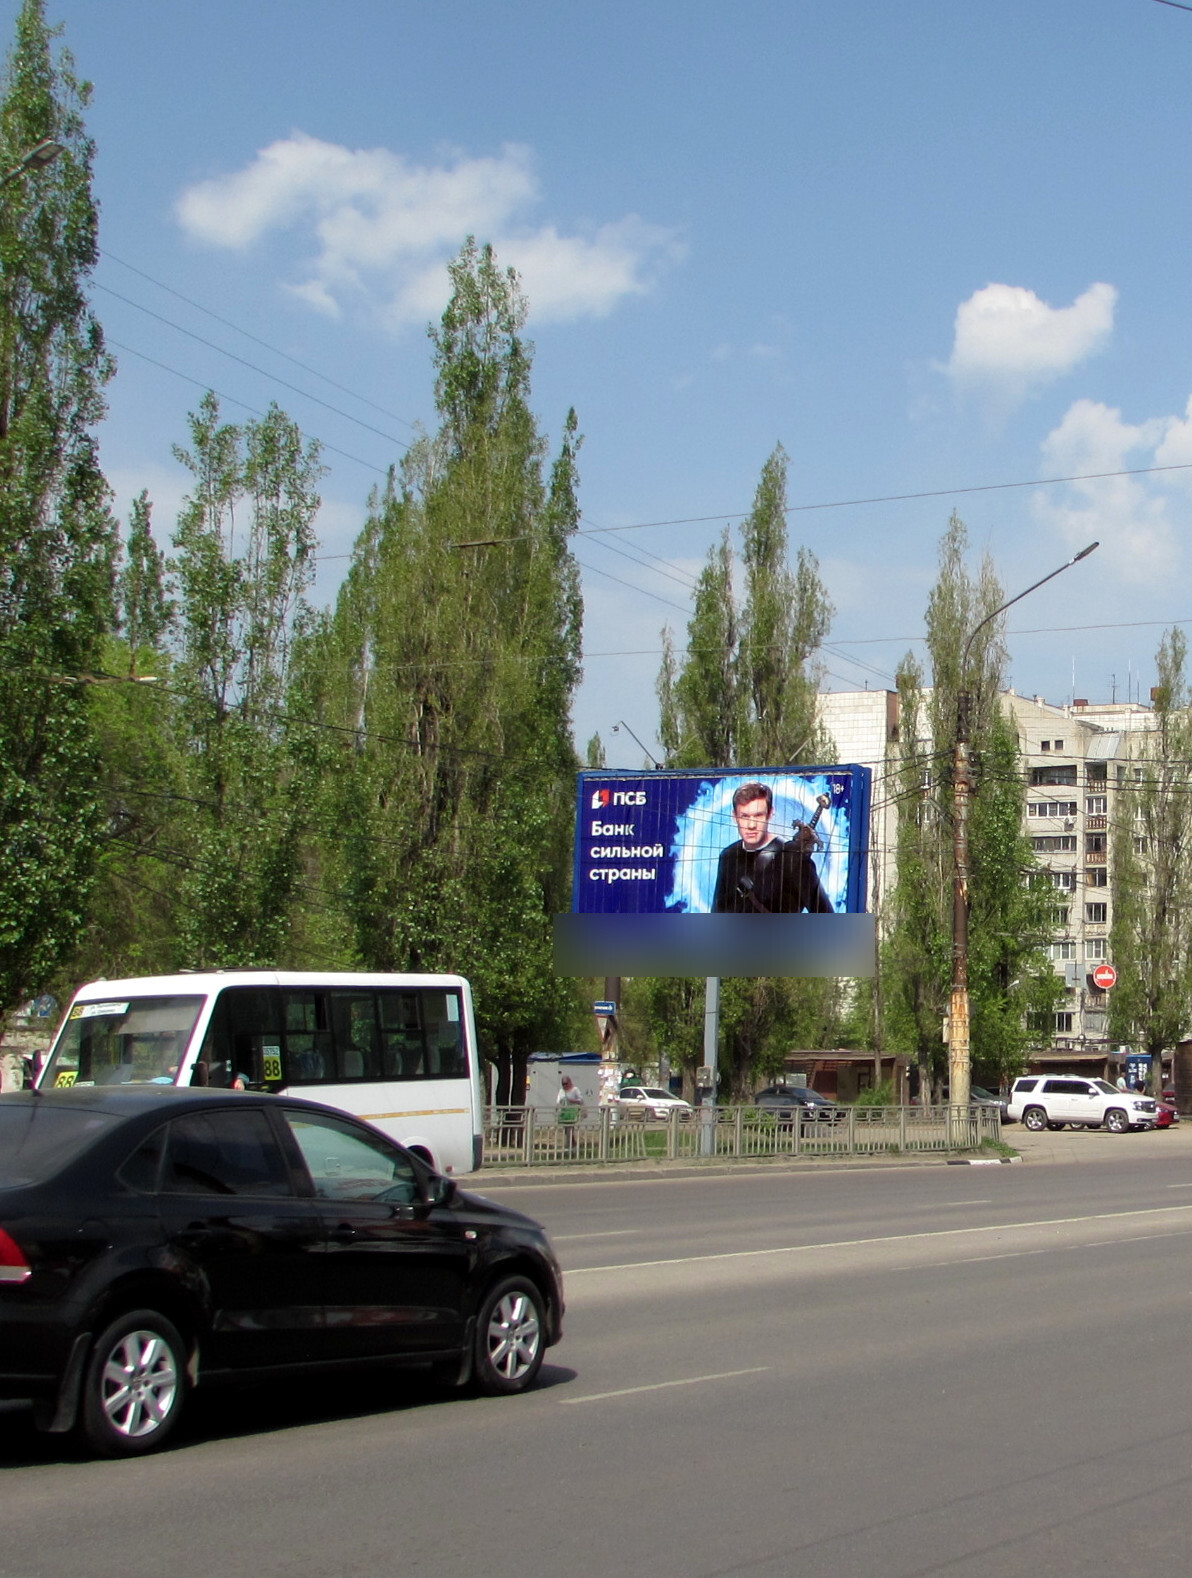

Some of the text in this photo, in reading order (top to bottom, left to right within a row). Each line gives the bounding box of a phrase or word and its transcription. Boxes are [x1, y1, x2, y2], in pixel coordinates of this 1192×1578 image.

[832, 783, 844, 795] 18+
[613, 791, 647, 806] ПСБ
[591, 820, 635, 836] Банк
[590, 843, 664, 858] сильной
[589, 867, 656, 884] страны
[264, 1060, 280, 1077] 88
[56, 1075, 75, 1088] 88
